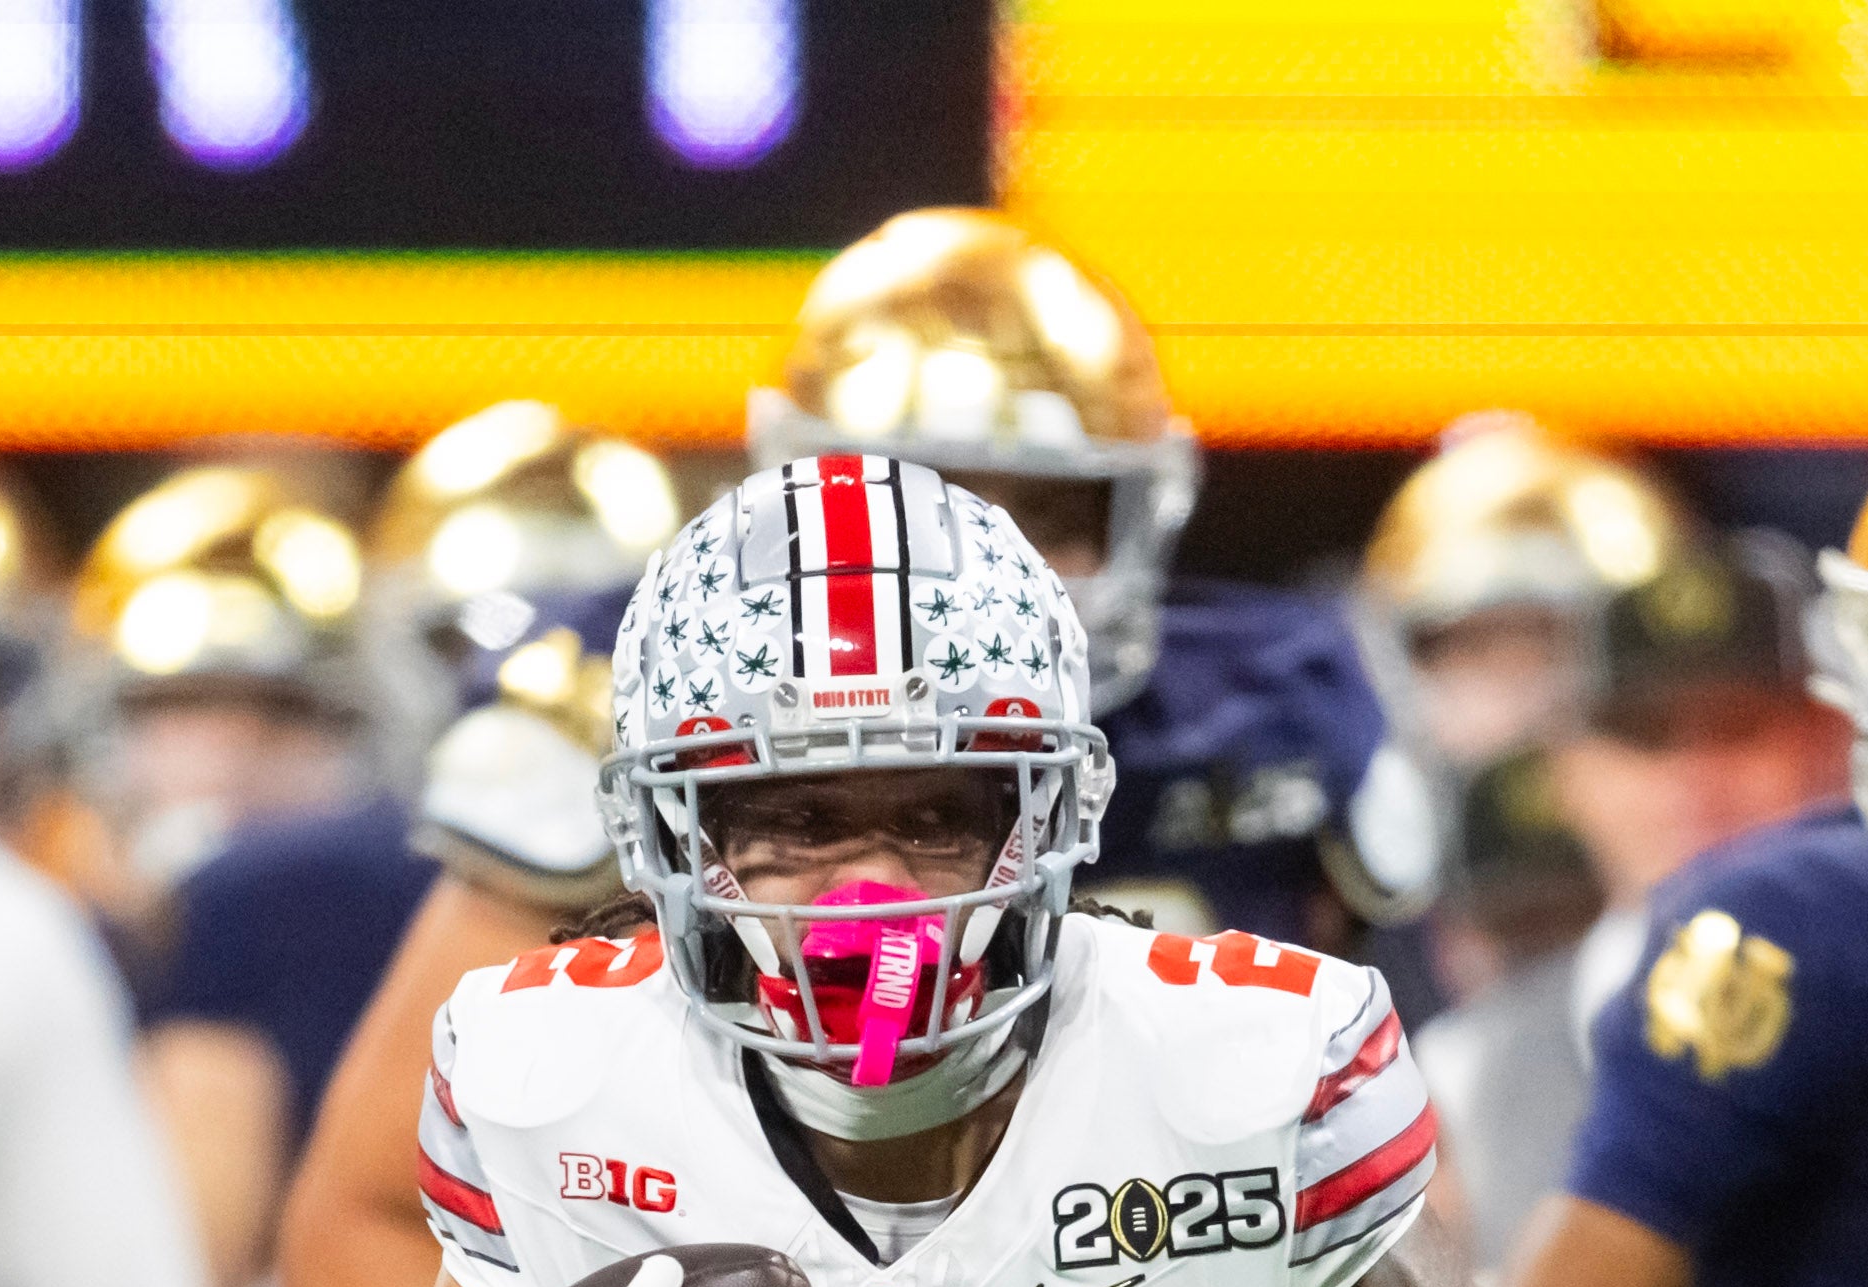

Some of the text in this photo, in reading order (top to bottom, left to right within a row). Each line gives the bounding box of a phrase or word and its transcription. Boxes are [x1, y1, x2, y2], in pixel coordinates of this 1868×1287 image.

[813, 688, 891, 709] OHIO STATE
[1052, 1166, 1287, 1271] 2025
